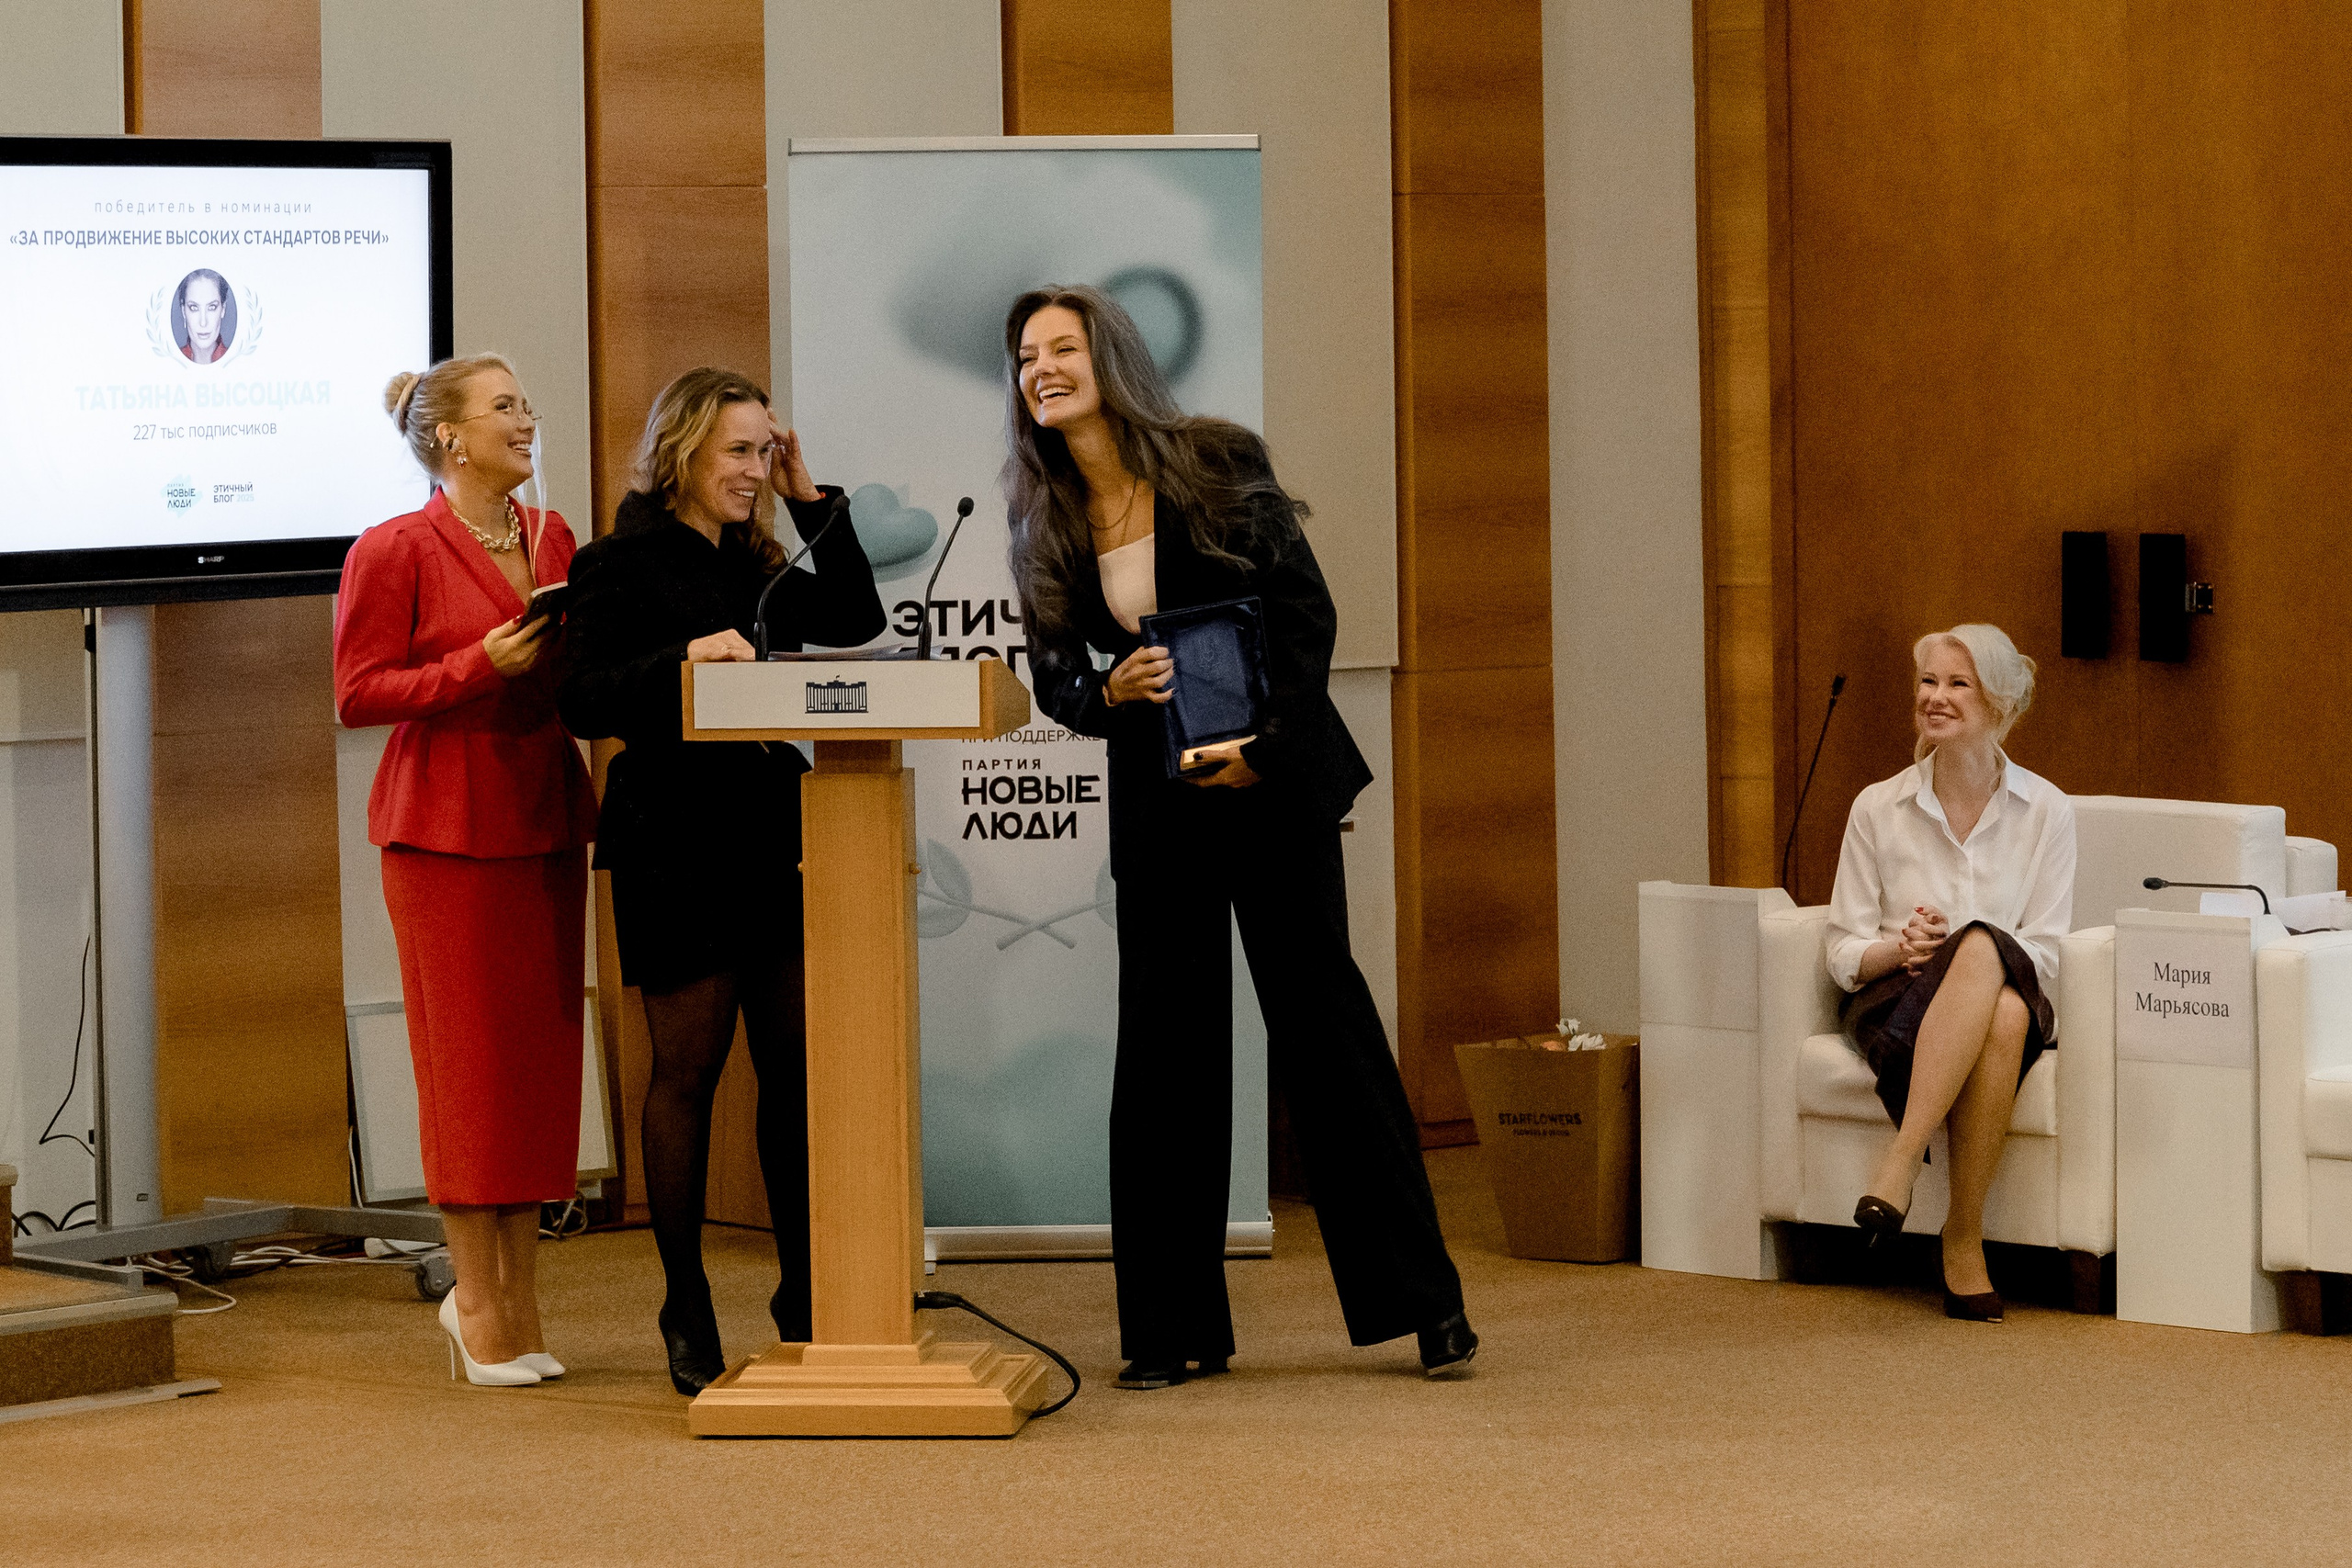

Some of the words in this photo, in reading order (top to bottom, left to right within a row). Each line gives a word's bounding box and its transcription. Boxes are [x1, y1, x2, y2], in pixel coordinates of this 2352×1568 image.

[94, 198, 196, 215] победитель
[204, 202, 211, 213] в
[220, 202, 311, 216] номинации
[9, 230, 39, 245] «ЗА
[43, 230, 163, 249] ПРОДВИЖЕНИЕ
[165, 230, 240, 245] ВЫСОКИХ
[243, 230, 341, 248] СТАНДАРТОВ
[344, 230, 390, 245] РЕЧИ»
[74, 383, 188, 411] ТАТЬЯНА
[195, 379, 332, 412] ВЫСОЦКАЯ
[132, 423, 157, 441] 227
[166, 488, 196, 498] НОВЫЕ
[213, 481, 254, 493] ЭТИЧНЫЙ
[167, 499, 192, 509] ЛЮДИ
[213, 494, 235, 503] БЛОГ
[892, 599, 1027, 637] ЭТИЧ
[962, 759, 1041, 771] ПАРТИЯ
[961, 774, 1101, 806] НОВЫЕ
[961, 811, 1078, 840] ЛЮДИ
[2154, 962, 2211, 989] Мария
[2135, 991, 2230, 1019] Марьясова
[1498, 1112, 1582, 1125] STARFLOWERS
